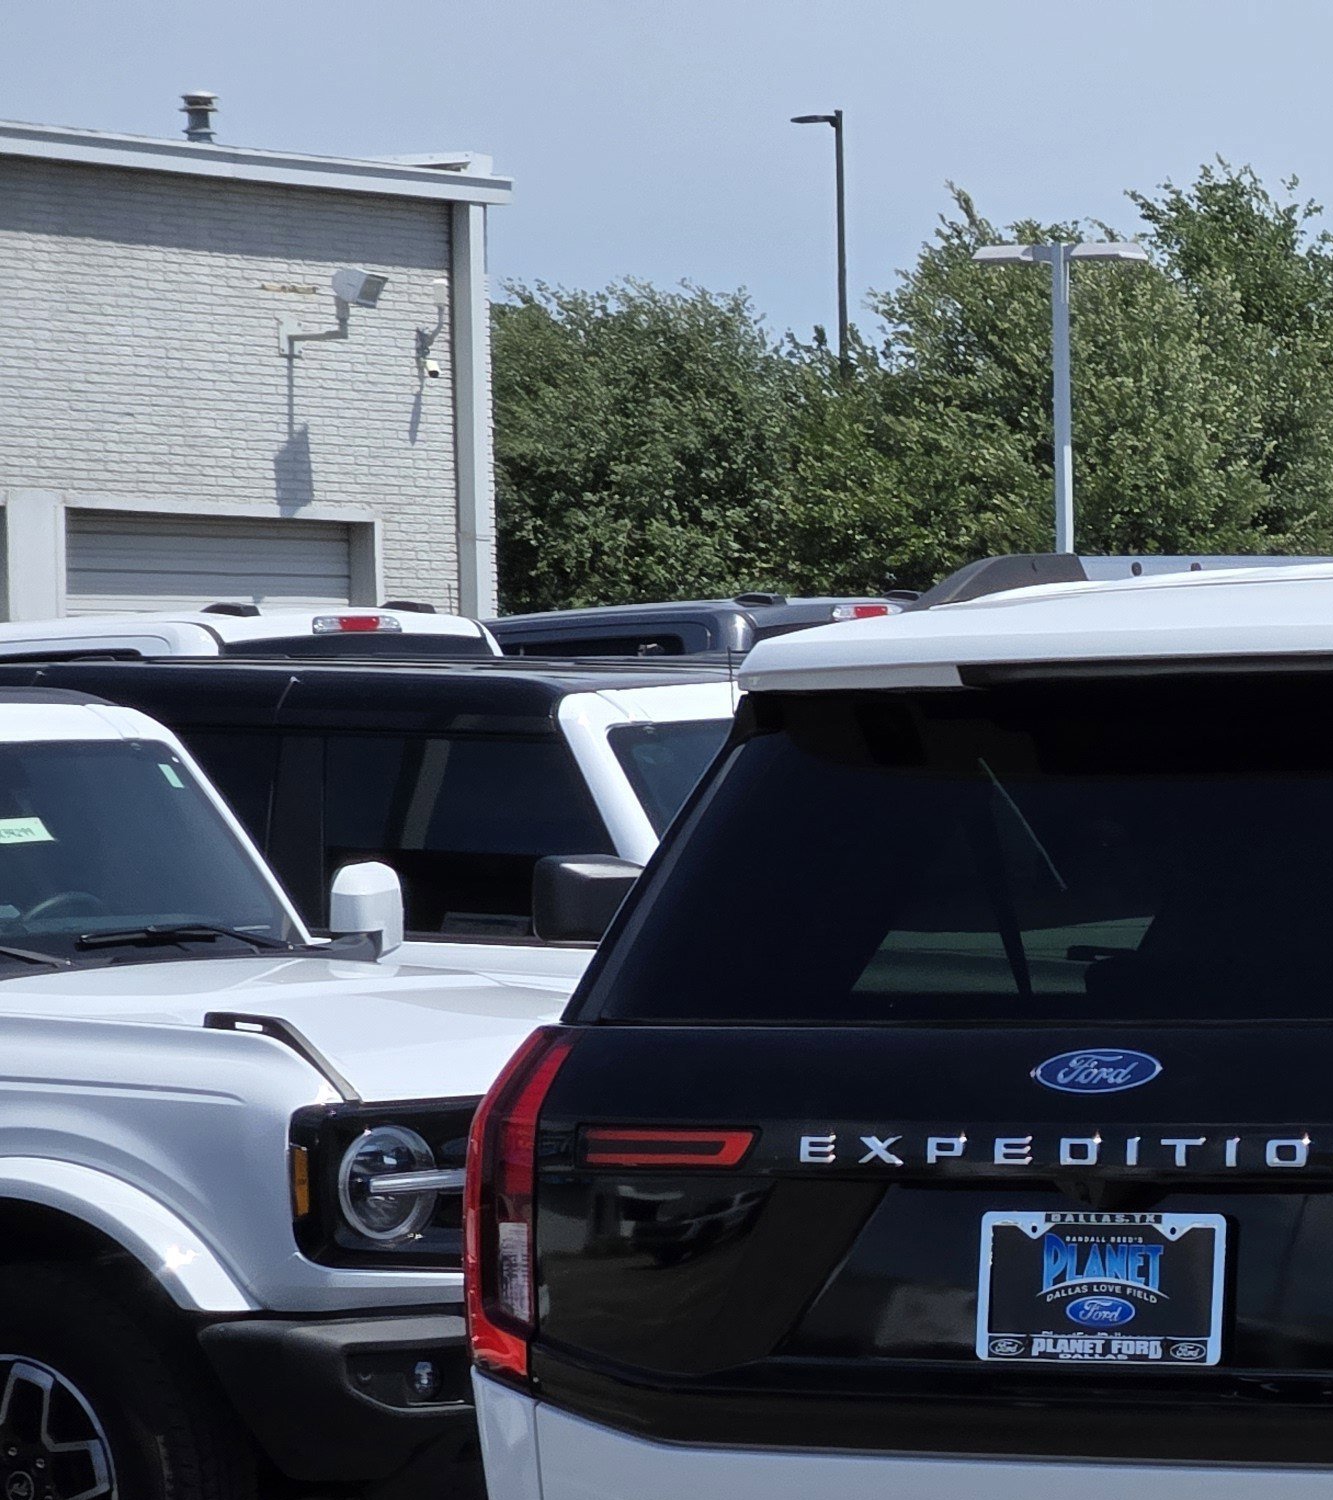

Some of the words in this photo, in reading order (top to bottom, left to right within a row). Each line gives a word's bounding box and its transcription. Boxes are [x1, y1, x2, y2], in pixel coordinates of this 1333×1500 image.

[1056, 1054, 1139, 1084] Ford
[1043, 1233, 1164, 1291] PLANET
[1046, 1284, 1089, 1303] DALLAS
[1092, 1284, 1122, 1293] LOVE
[1126, 1287, 1158, 1304] FIELD
[1079, 1300, 1122, 1322] Ford
[1031, 1337, 1105, 1356] PLANET
[1111, 1340, 1162, 1359] FORD
